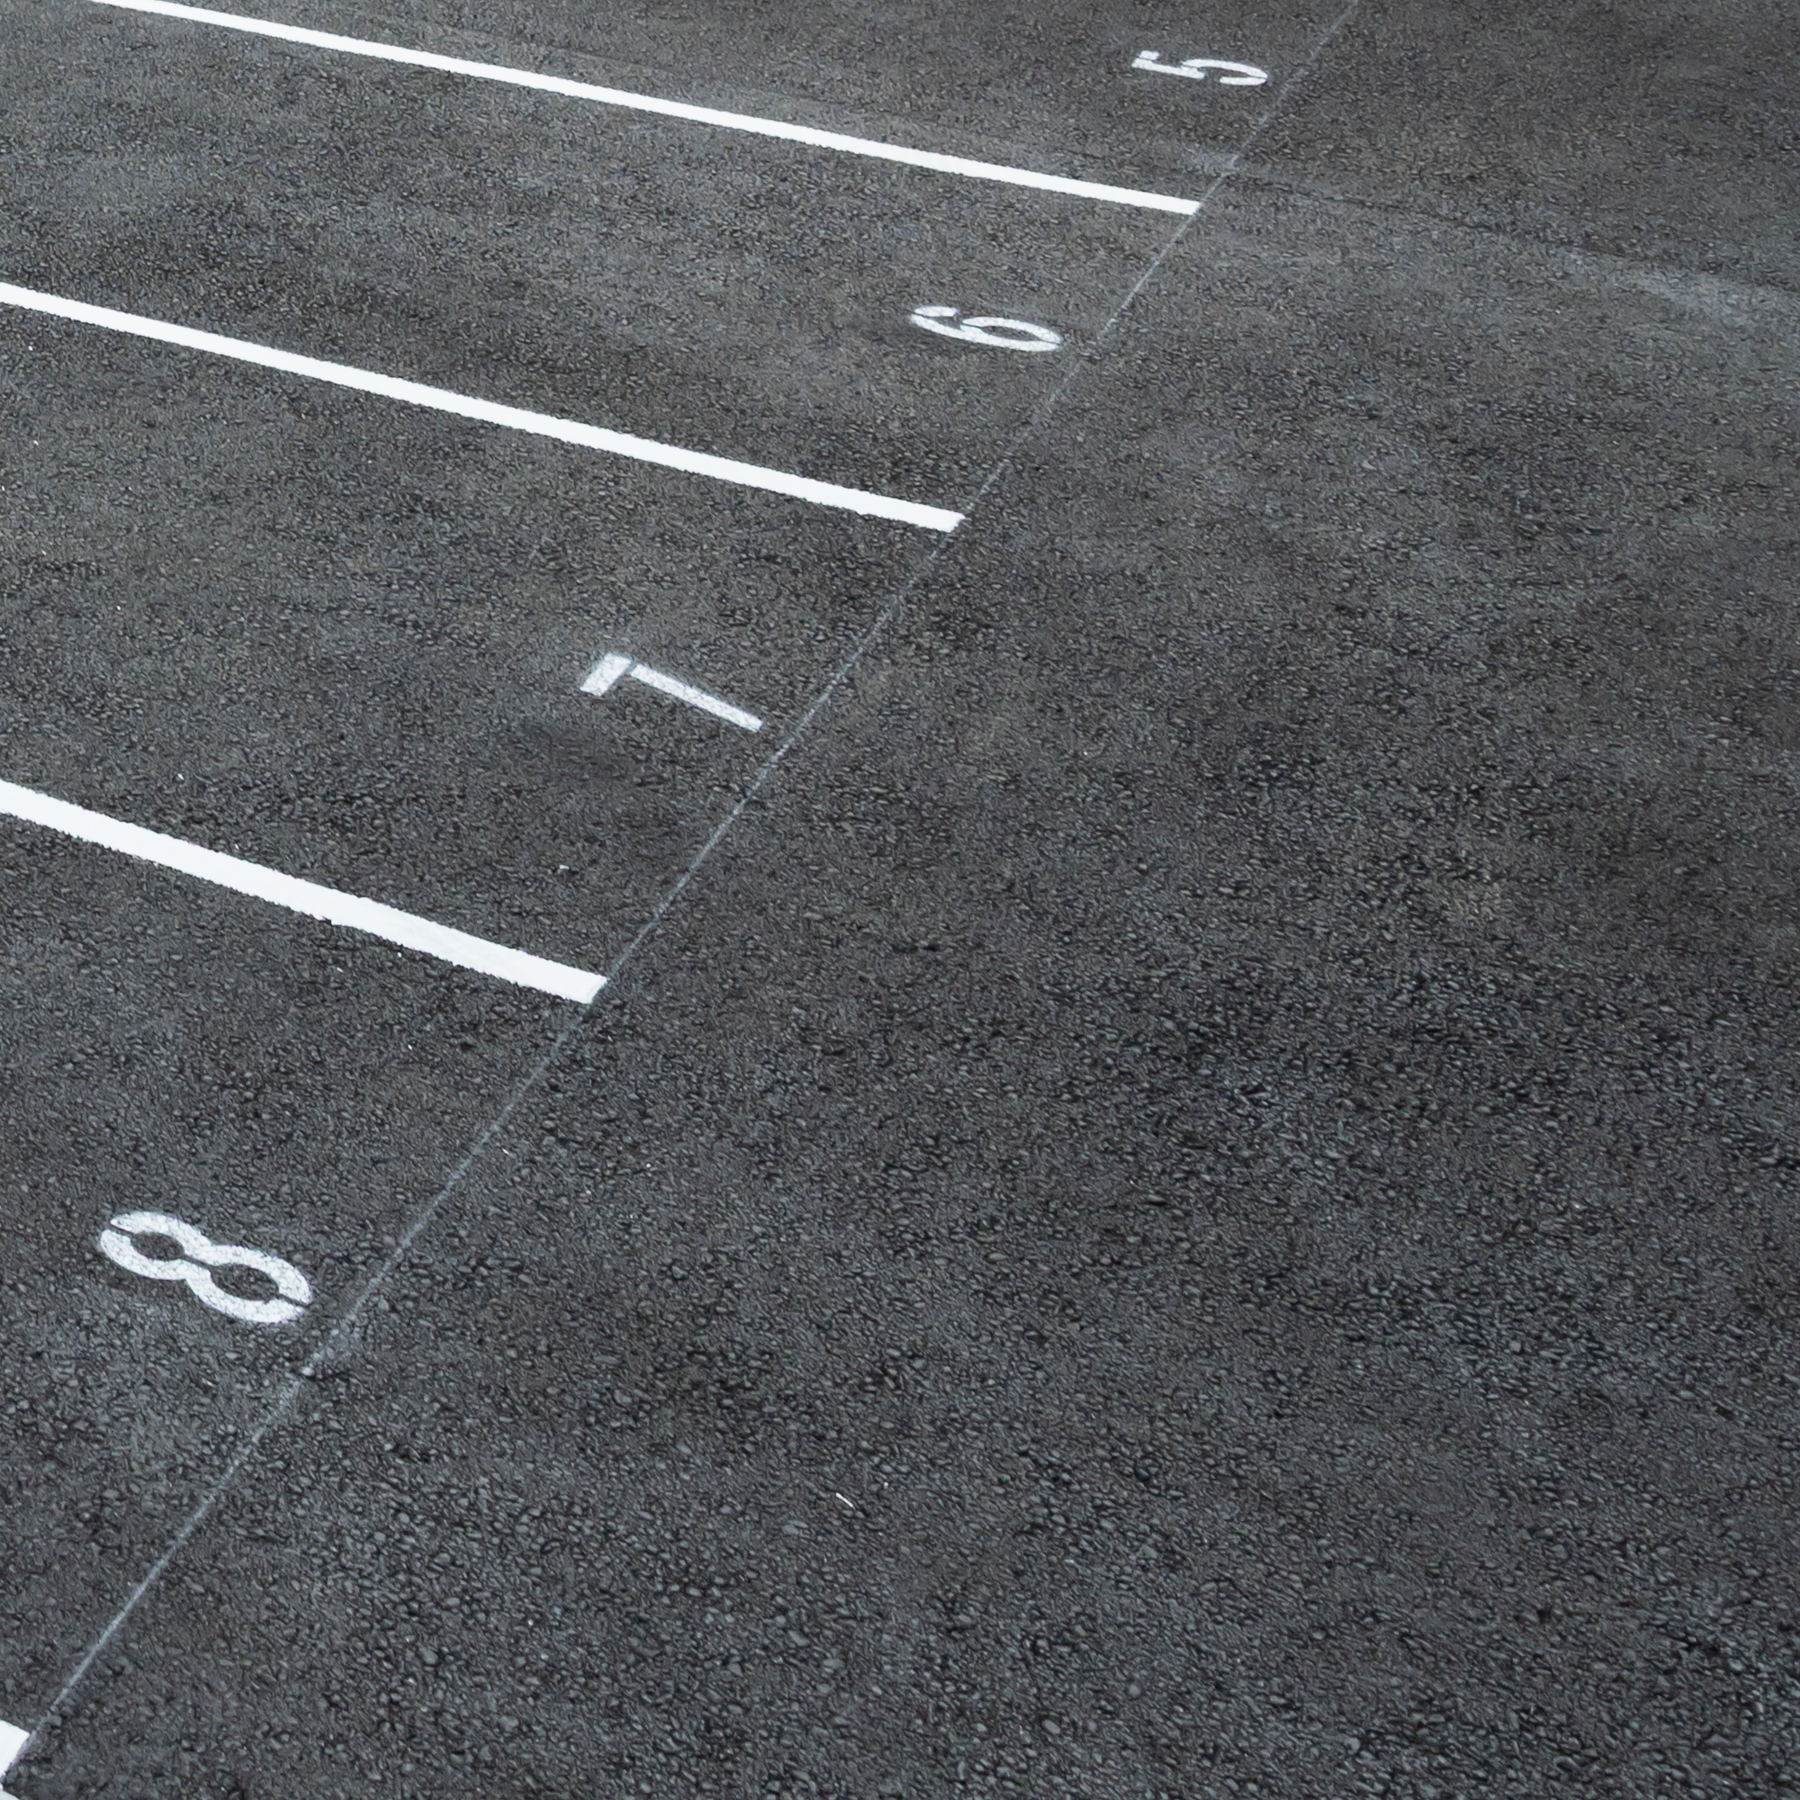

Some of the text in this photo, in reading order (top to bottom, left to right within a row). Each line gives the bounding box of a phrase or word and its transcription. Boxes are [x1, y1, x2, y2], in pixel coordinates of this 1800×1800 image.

[1131, 49, 1269, 87] 5
[910, 304, 1063, 353] 6
[578, 652, 764, 733] 7
[99, 1210, 314, 1325] 8
